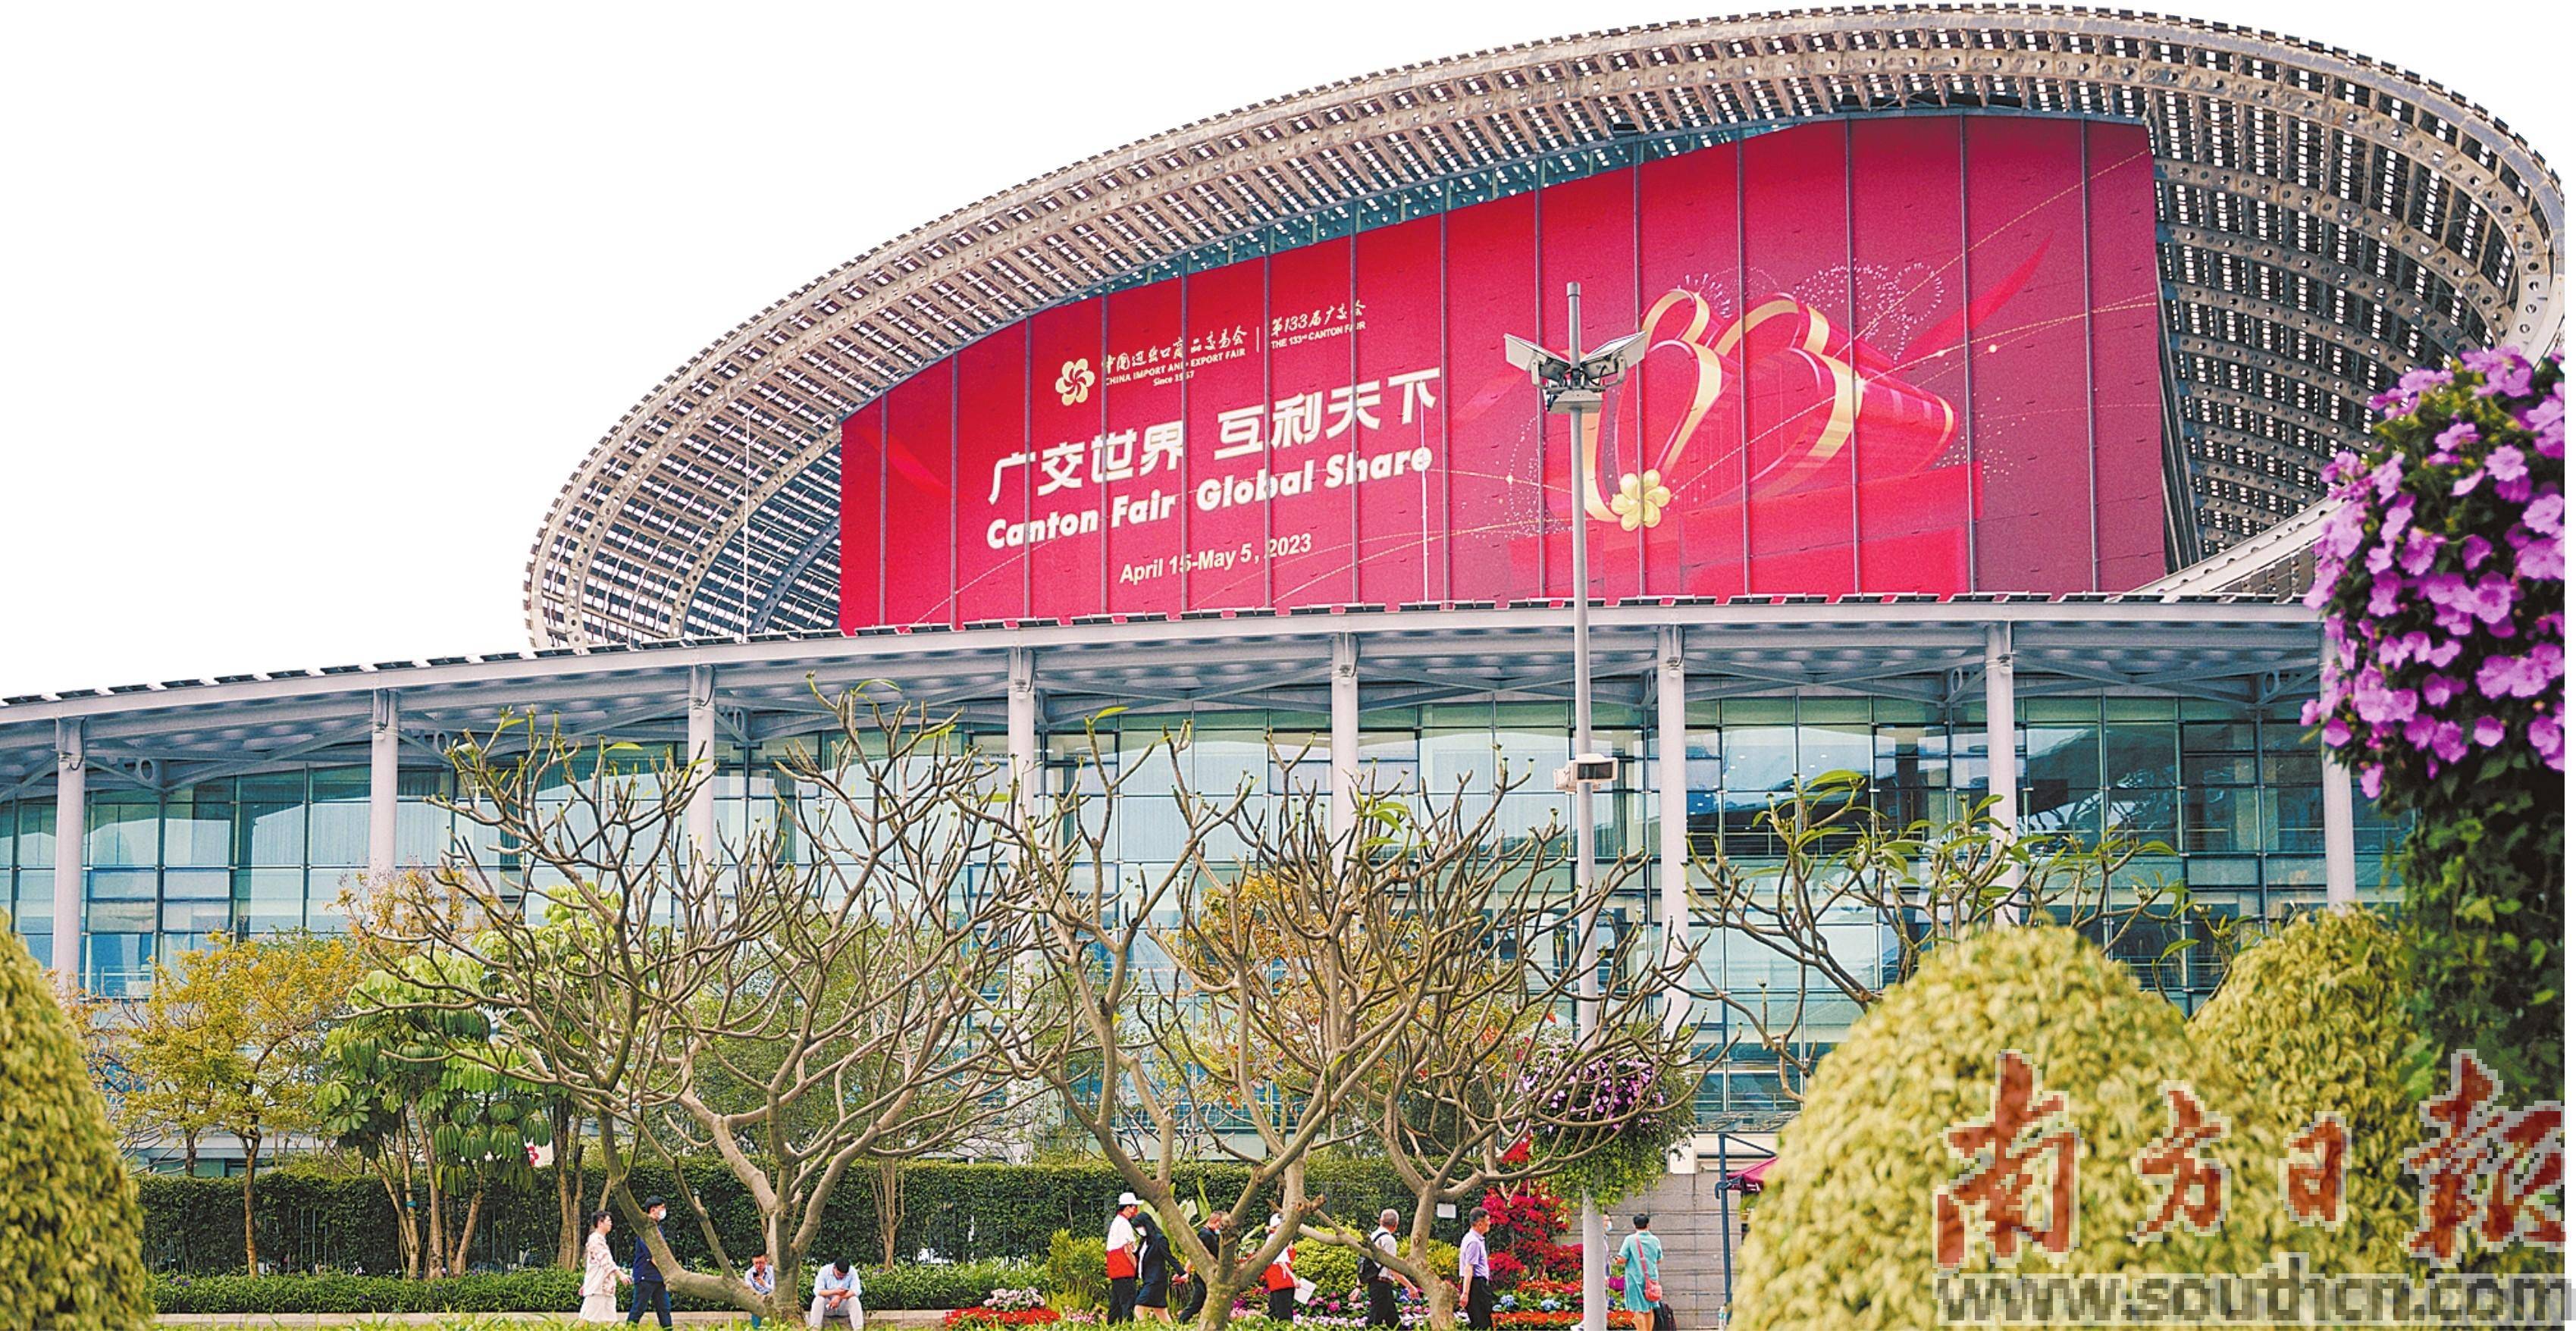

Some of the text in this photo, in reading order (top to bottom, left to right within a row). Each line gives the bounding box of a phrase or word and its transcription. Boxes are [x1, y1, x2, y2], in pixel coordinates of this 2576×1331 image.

[1271, 338, 1287, 350] THE
[1308, 325, 1343, 341] CANTON
[1105, 374, 1131, 387] CHINA
[1133, 365, 1165, 380] IMPORT
[1190, 352, 1224, 367] EXPORT
[1225, 348, 1246, 359] FAIR
[1152, 377, 1173, 387] Since
[988, 368, 1440, 505] 广交世界 互利天下
[986, 446, 1433, 550] Canton Fair Global Share
[1119, 554, 1164, 584] April
[1168, 548, 1236, 575] 15-May
[1264, 533, 1312, 559] 2023
